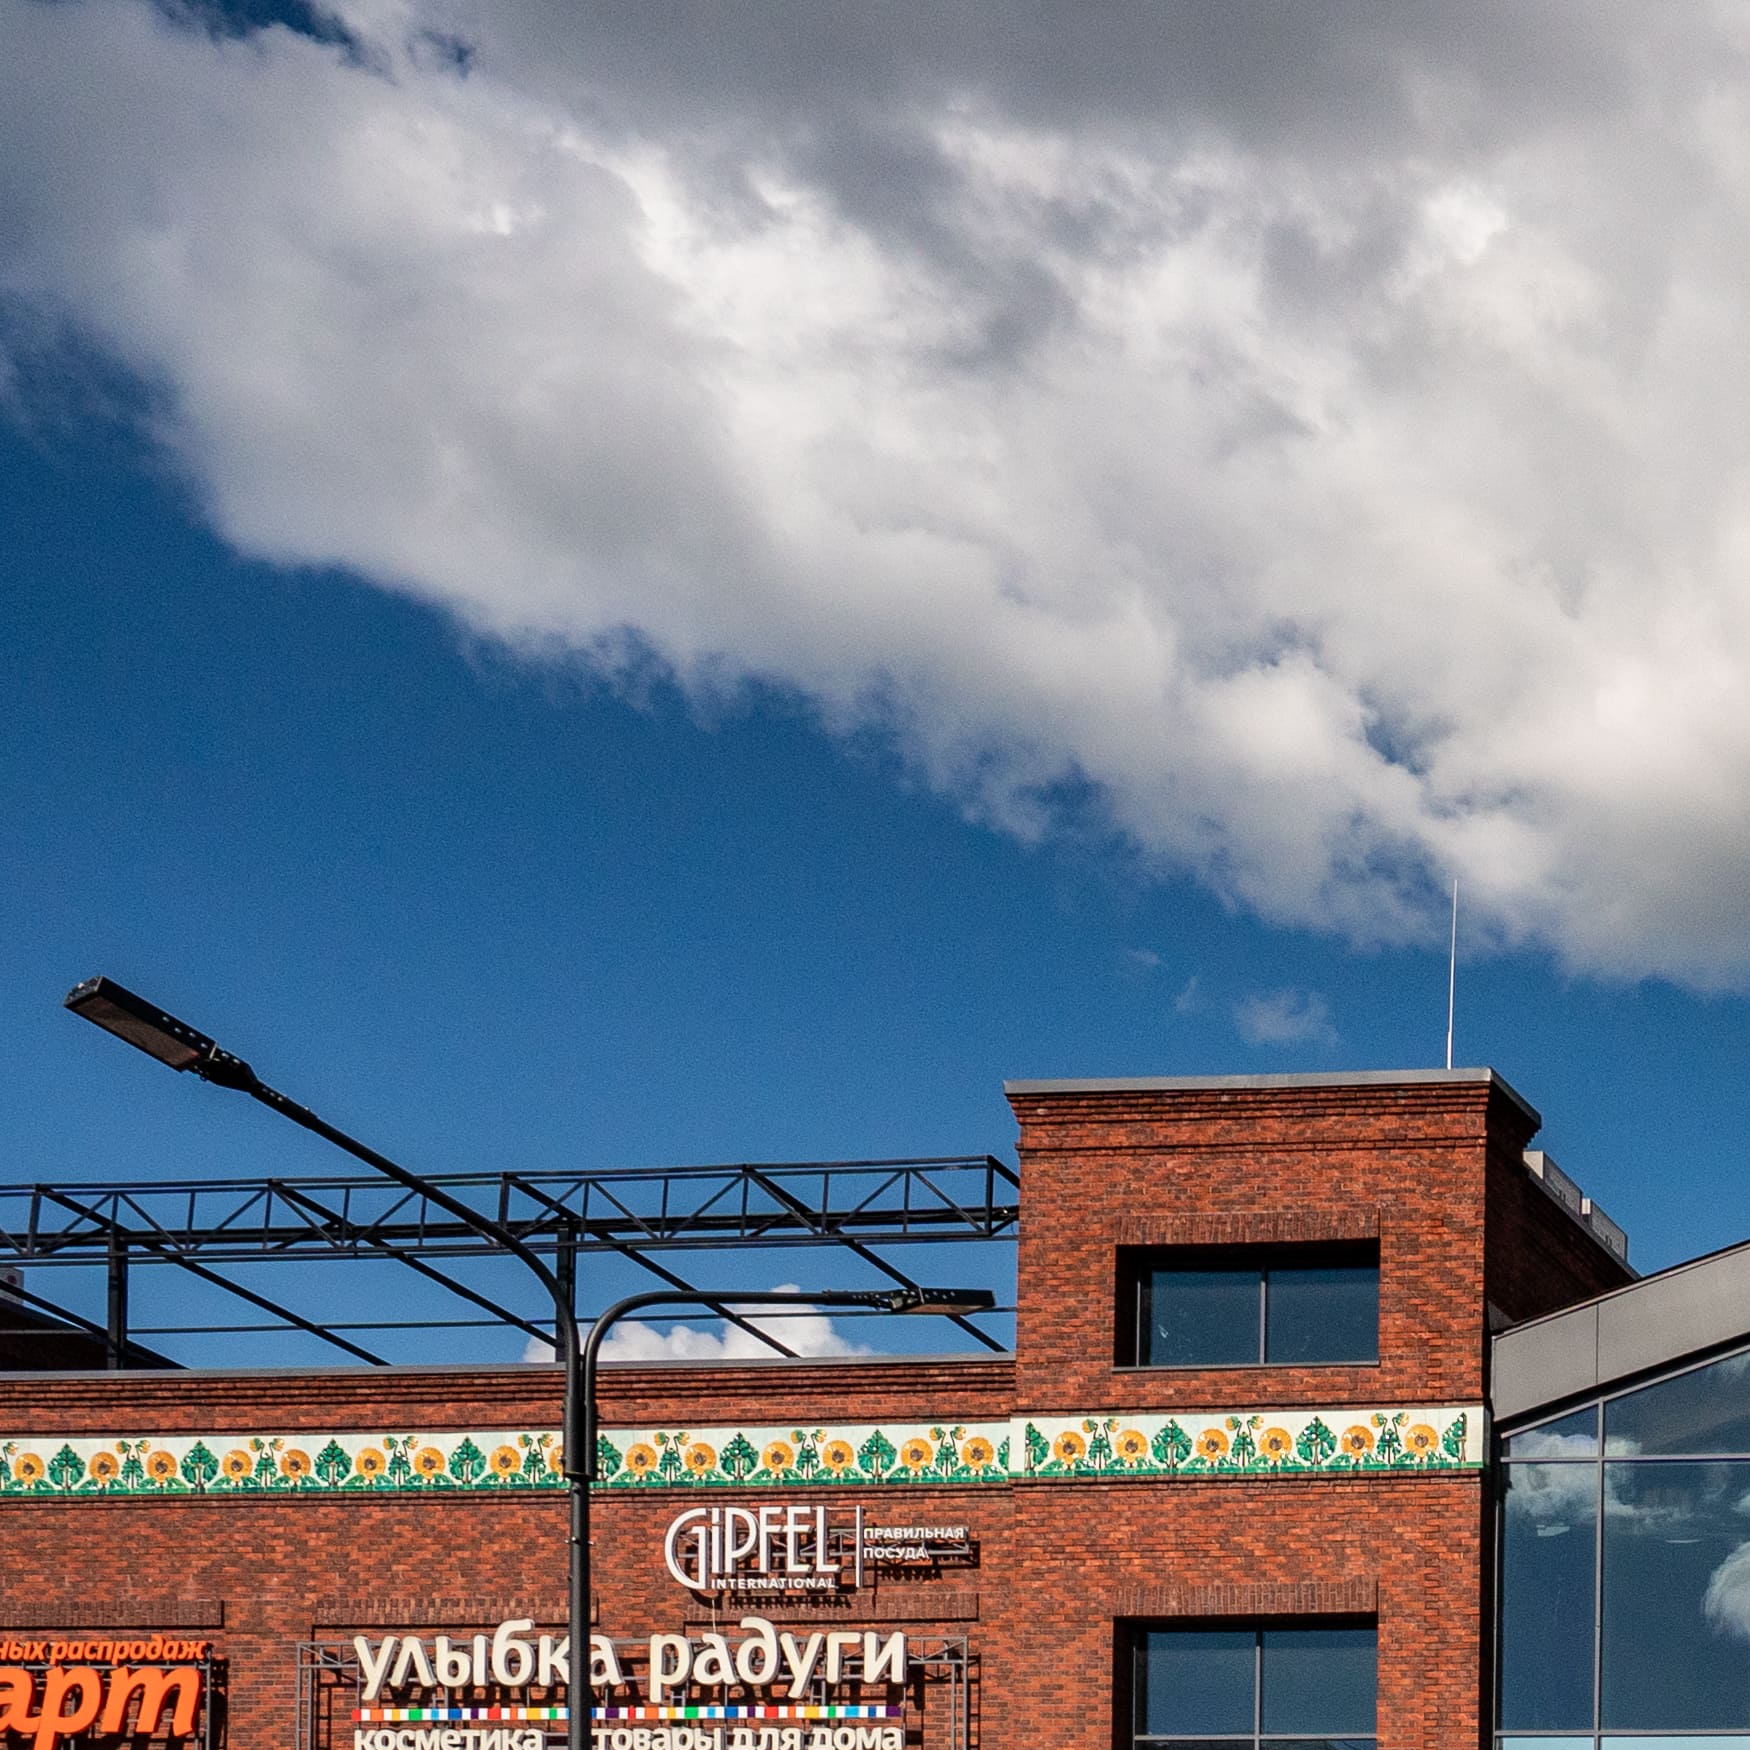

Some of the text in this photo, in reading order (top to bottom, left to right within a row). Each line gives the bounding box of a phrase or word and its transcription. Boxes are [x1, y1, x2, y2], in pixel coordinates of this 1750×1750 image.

[863, 1527, 965, 1539] ПРАВИЛЬНАЯ
[863, 1547, 926, 1559] ПОСУДА
[711, 1578, 836, 1590] INTERNATIONAL
[50, 1635, 206, 1665] распродаж
[353, 1617, 906, 1702] улыбка радуги
